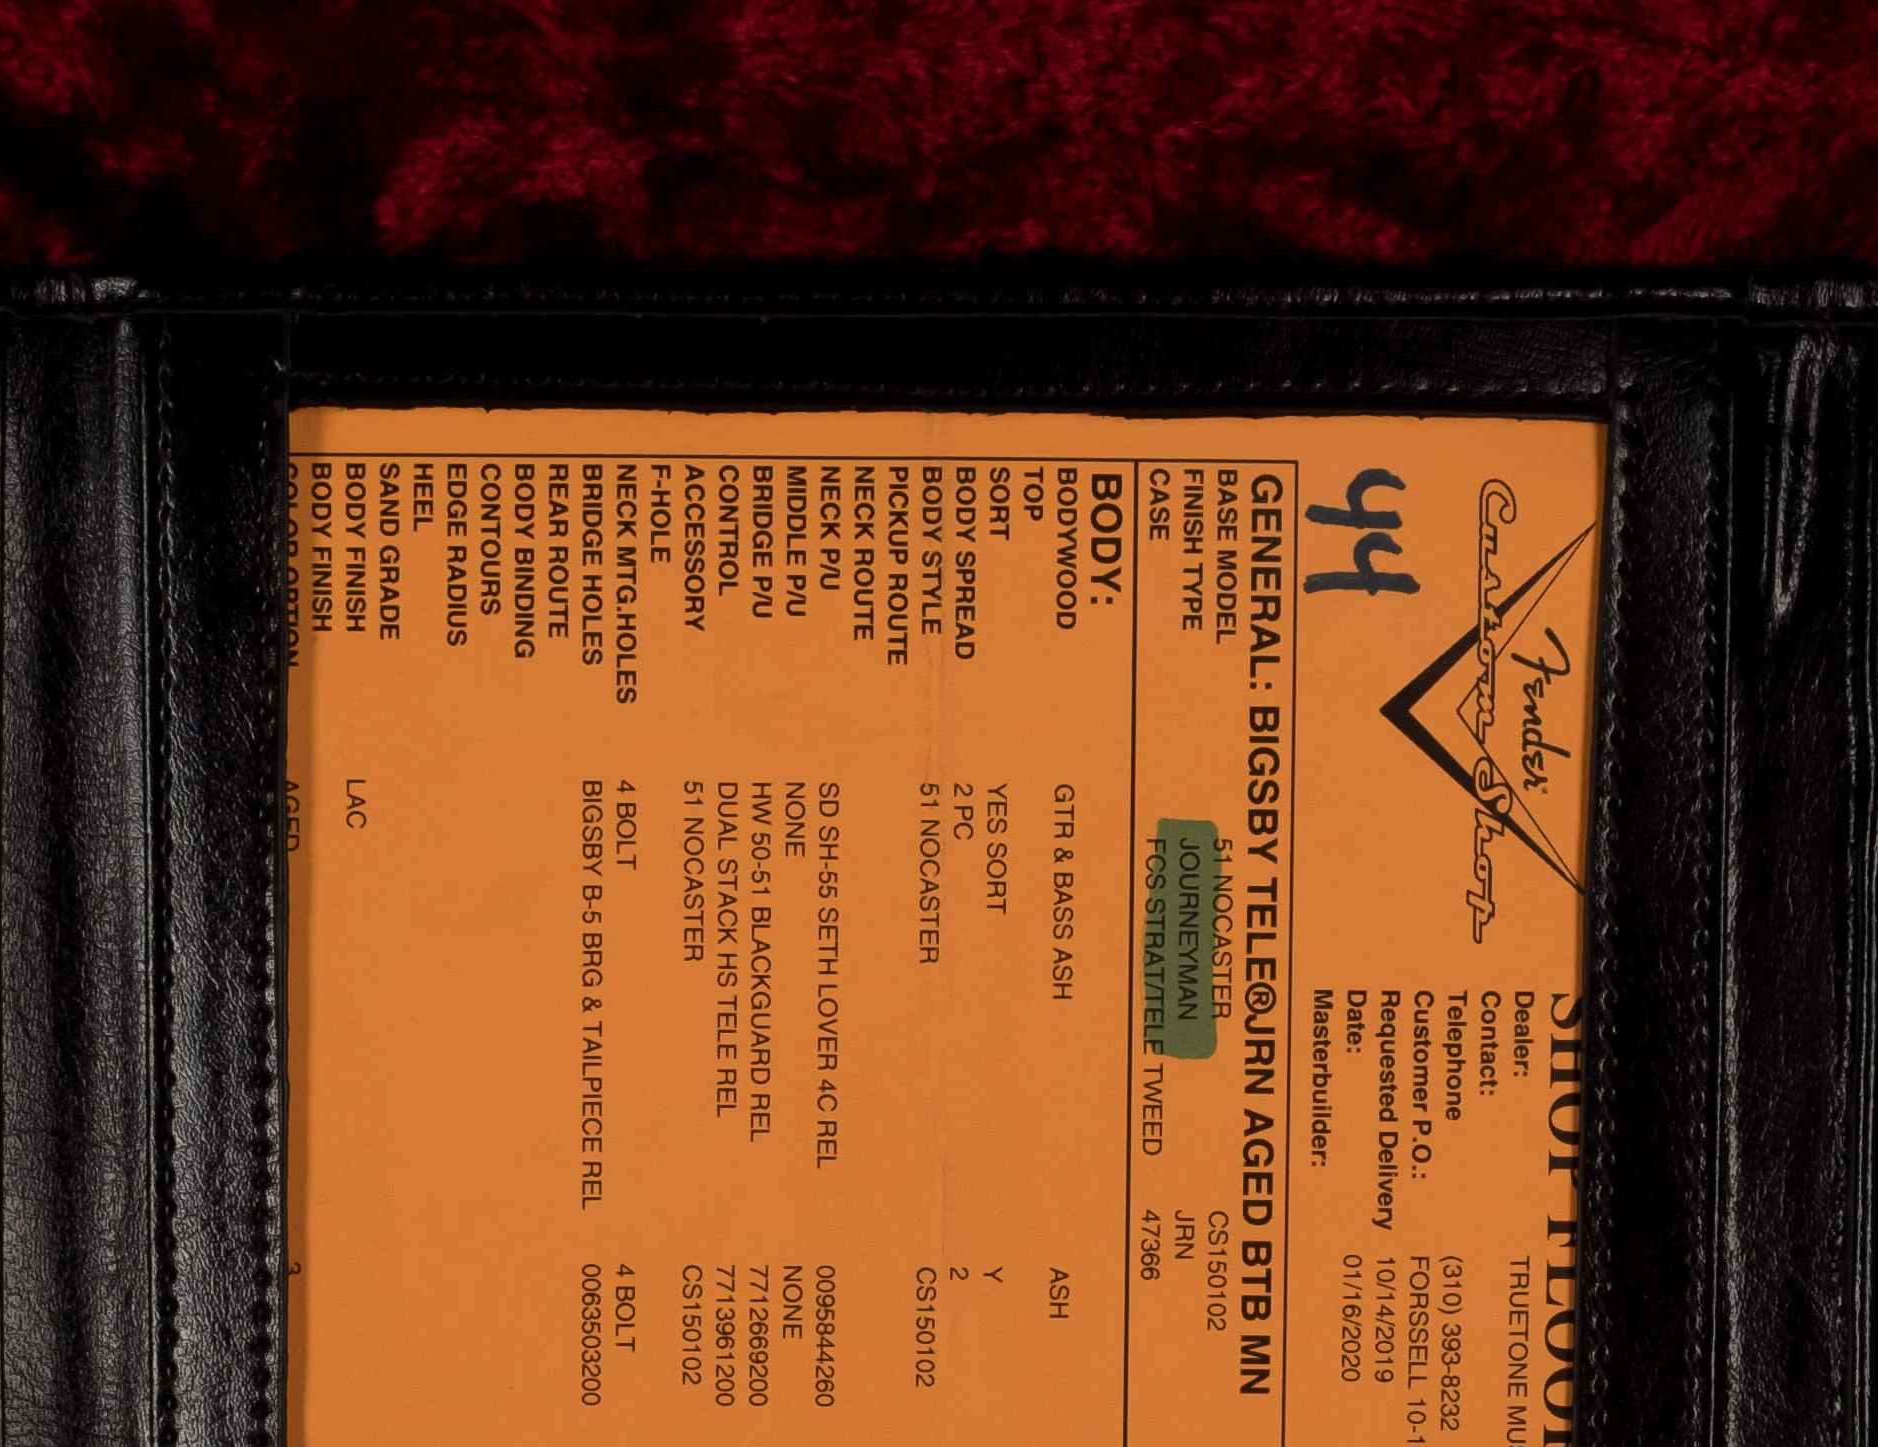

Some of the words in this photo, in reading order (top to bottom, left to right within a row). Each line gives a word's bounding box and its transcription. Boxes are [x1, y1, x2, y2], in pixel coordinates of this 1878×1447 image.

[380, 463, 400, 536] SAND
[480, 463, 501, 615] CONTOURS
[888, 467, 909, 565] PICKUP
[1090, 474, 1123, 604] BODY:
[379, 545, 400, 640] GRADE
[887, 574, 908, 665] ROUTE
[1250, 474, 1283, 690] GENERAL:
[1475, 478, 1517, 744] Custom
[751, 783, 772, 825] HW
[1248, 706, 1280, 864] BIGSBY
[751, 833, 771, 894] 50-51
[1466, 758, 1514, 944] Shop
[1177, 837, 1200, 1021] JOURNEYMAN
[750, 907, 771, 1084] BLACKGUARD
[1412, 990, 1434, 1112] Customer
[1479, 991, 1501, 1095] Contact:
[1513, 991, 1535, 1077] Dealer:
[1311, 990, 1333, 1166] Masterbuilder:
[1375, 990, 1400, 1122] Requested
[1442, 990, 1468, 1120] Telephone
[750, 1094, 770, 1142] REL
[1243, 1108, 1274, 1226] AGED
[1412, 1120, 1432, 1178] P.O.:
[1372, 1132, 1398, 1230] Delivery
[815, 1265, 835, 1407] 0095844260
[1241, 1240, 1272, 1321] BTB
[1375, 1257, 1396, 1383] 10/14/2019
[1437, 1256, 1463, 1314] (310)
[1508, 1256, 1530, 1397] TRUETONE
[1240, 1335, 1271, 1394] MN
[1440, 1323, 1461, 1431] 393-8232
